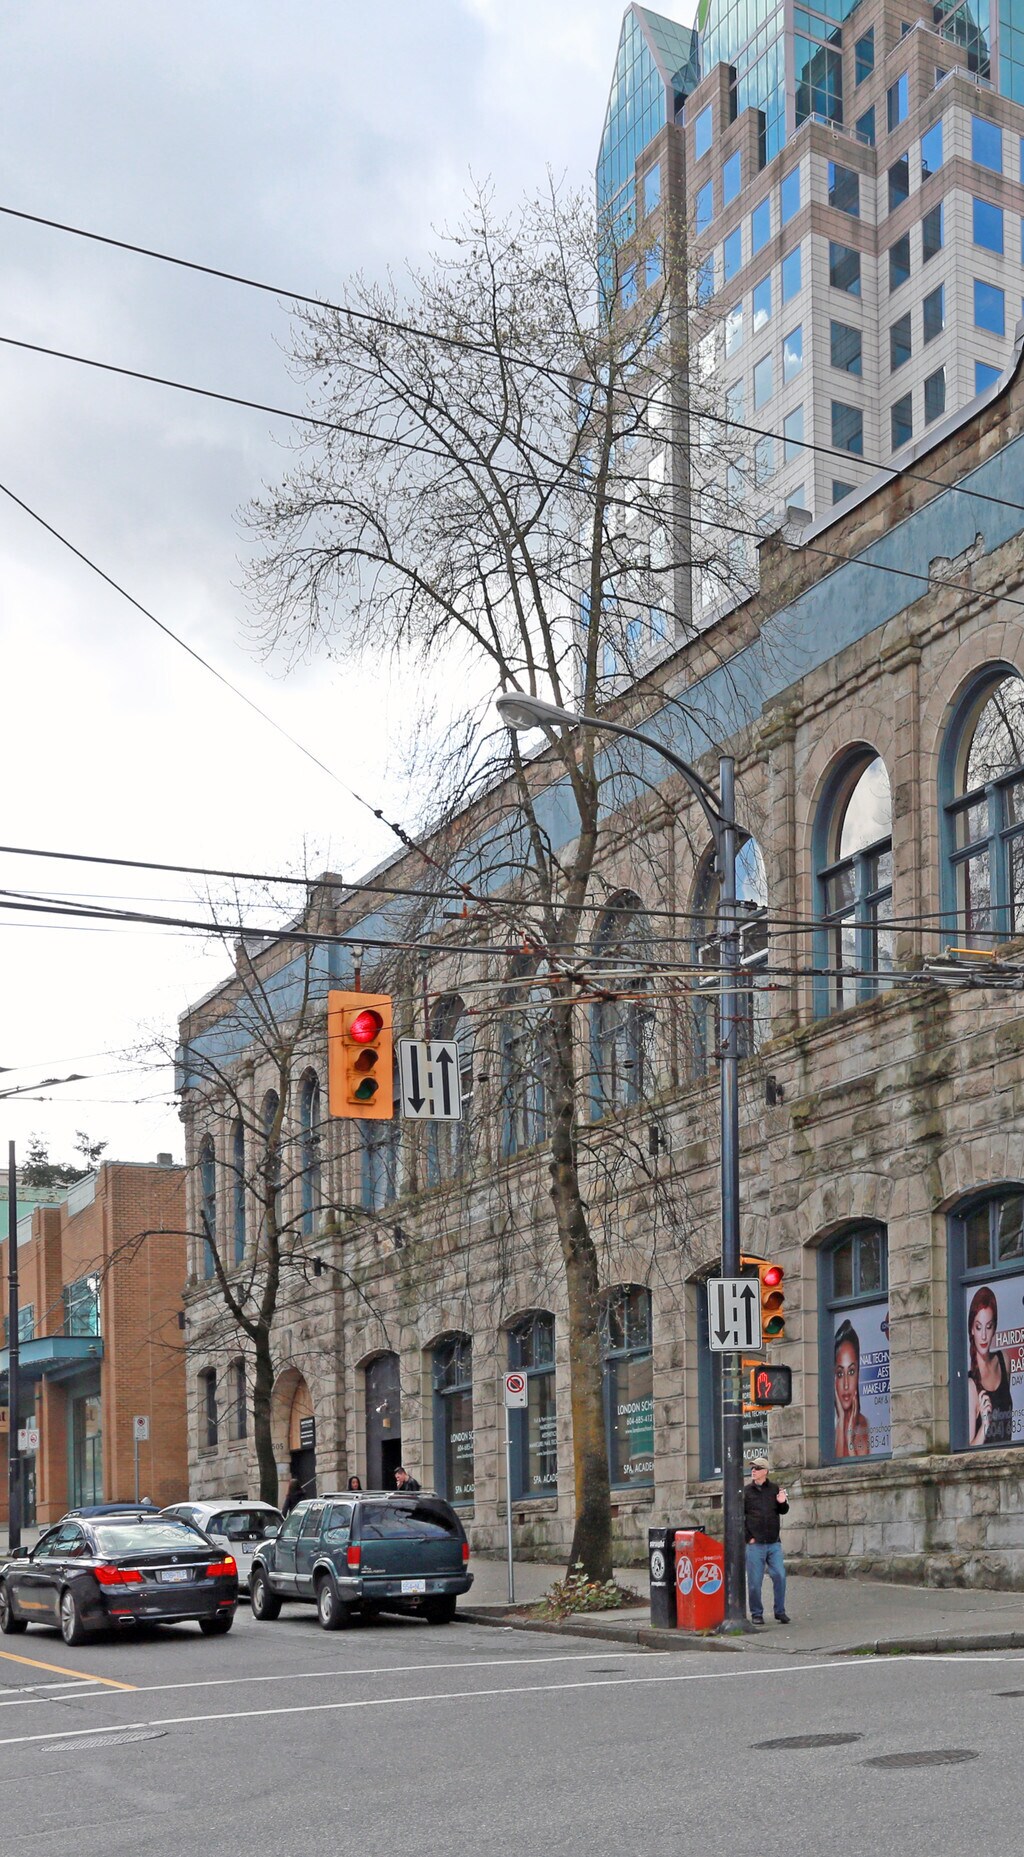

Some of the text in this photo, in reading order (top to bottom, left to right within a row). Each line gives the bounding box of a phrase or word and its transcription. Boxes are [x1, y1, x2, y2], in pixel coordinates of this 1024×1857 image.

[860, 1353, 872, 1365] NAIL
[1012, 1375, 1023, 1386] DAY
[862, 1382, 886, 1395] MAKE-UP
[617, 1402, 640, 1415] LONDON
[450, 1432, 468, 1443] LONDON
[623, 1463, 633, 1475] SPA
[679, 1561, 719, 1582] 24 24
